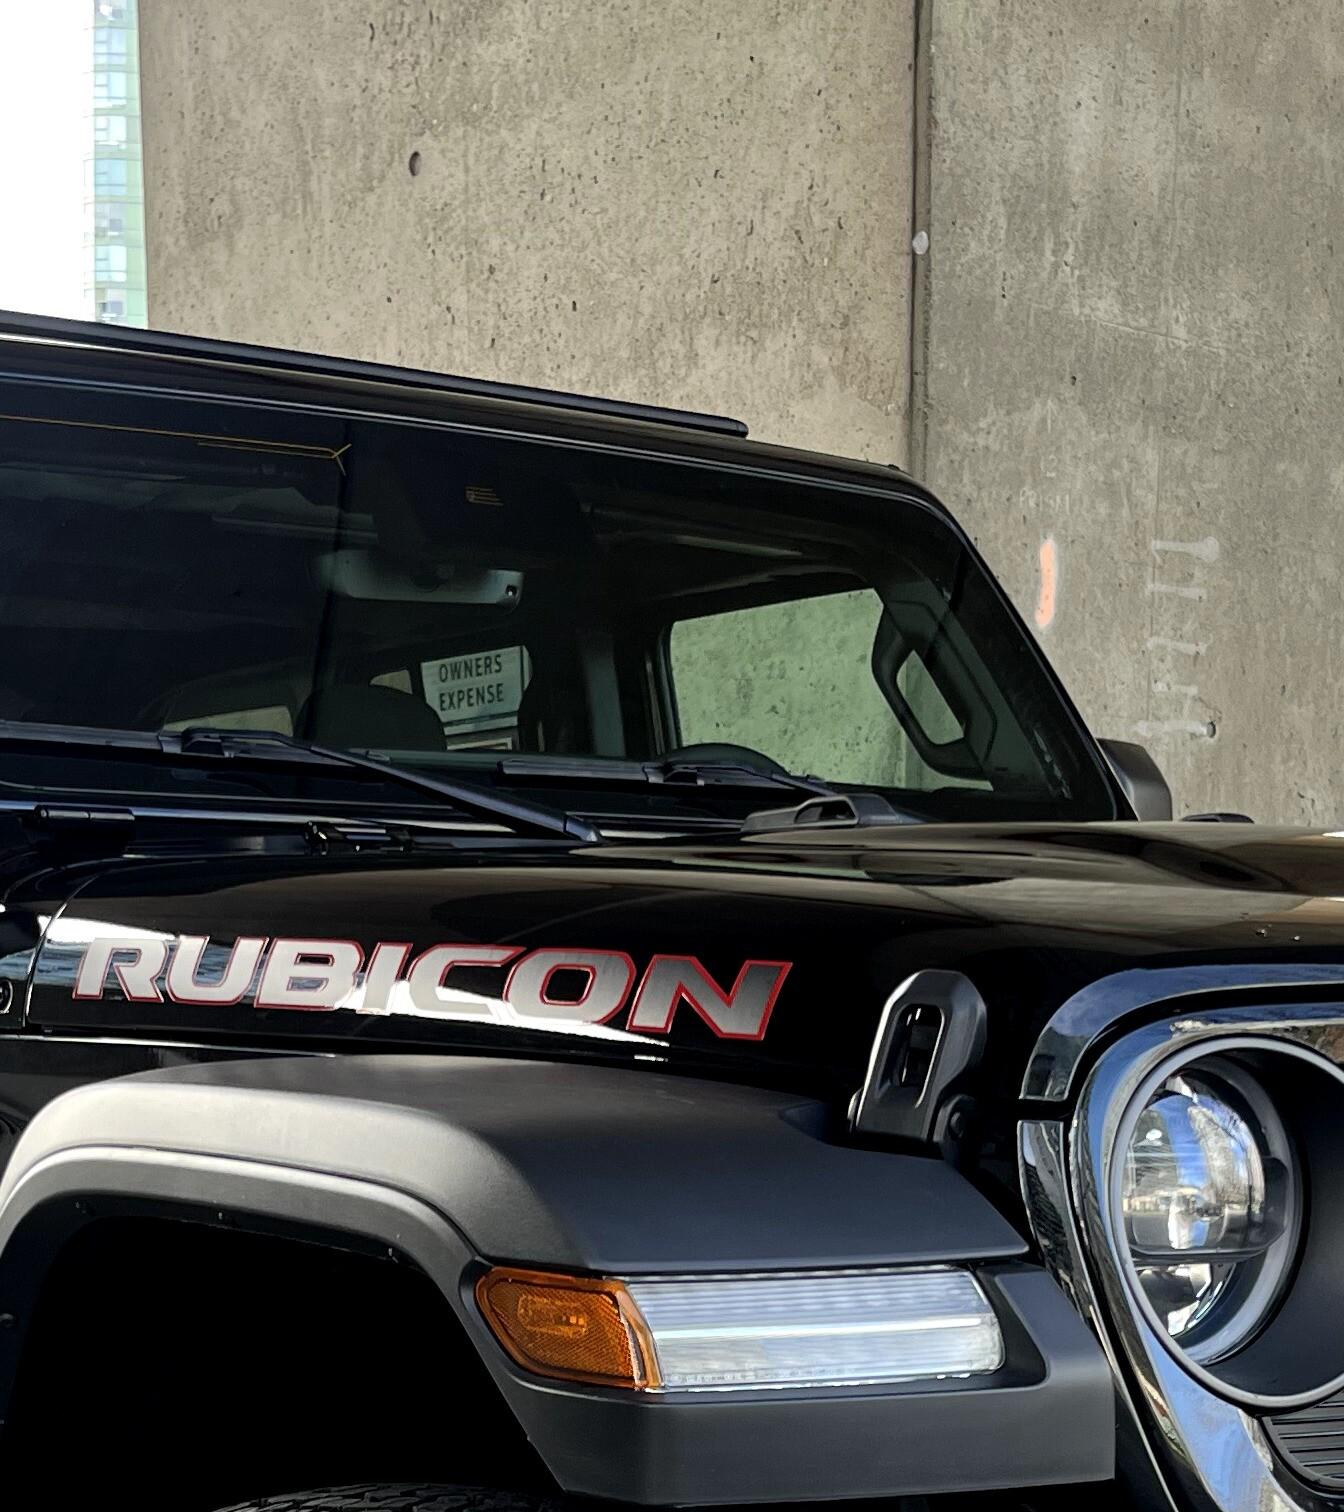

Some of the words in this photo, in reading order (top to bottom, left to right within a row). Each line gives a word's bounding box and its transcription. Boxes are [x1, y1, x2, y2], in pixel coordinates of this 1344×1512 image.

[438, 653, 503, 683] OWNERS
[439, 682, 504, 712] EXPENSE
[72, 936, 793, 1042] RUBICON
